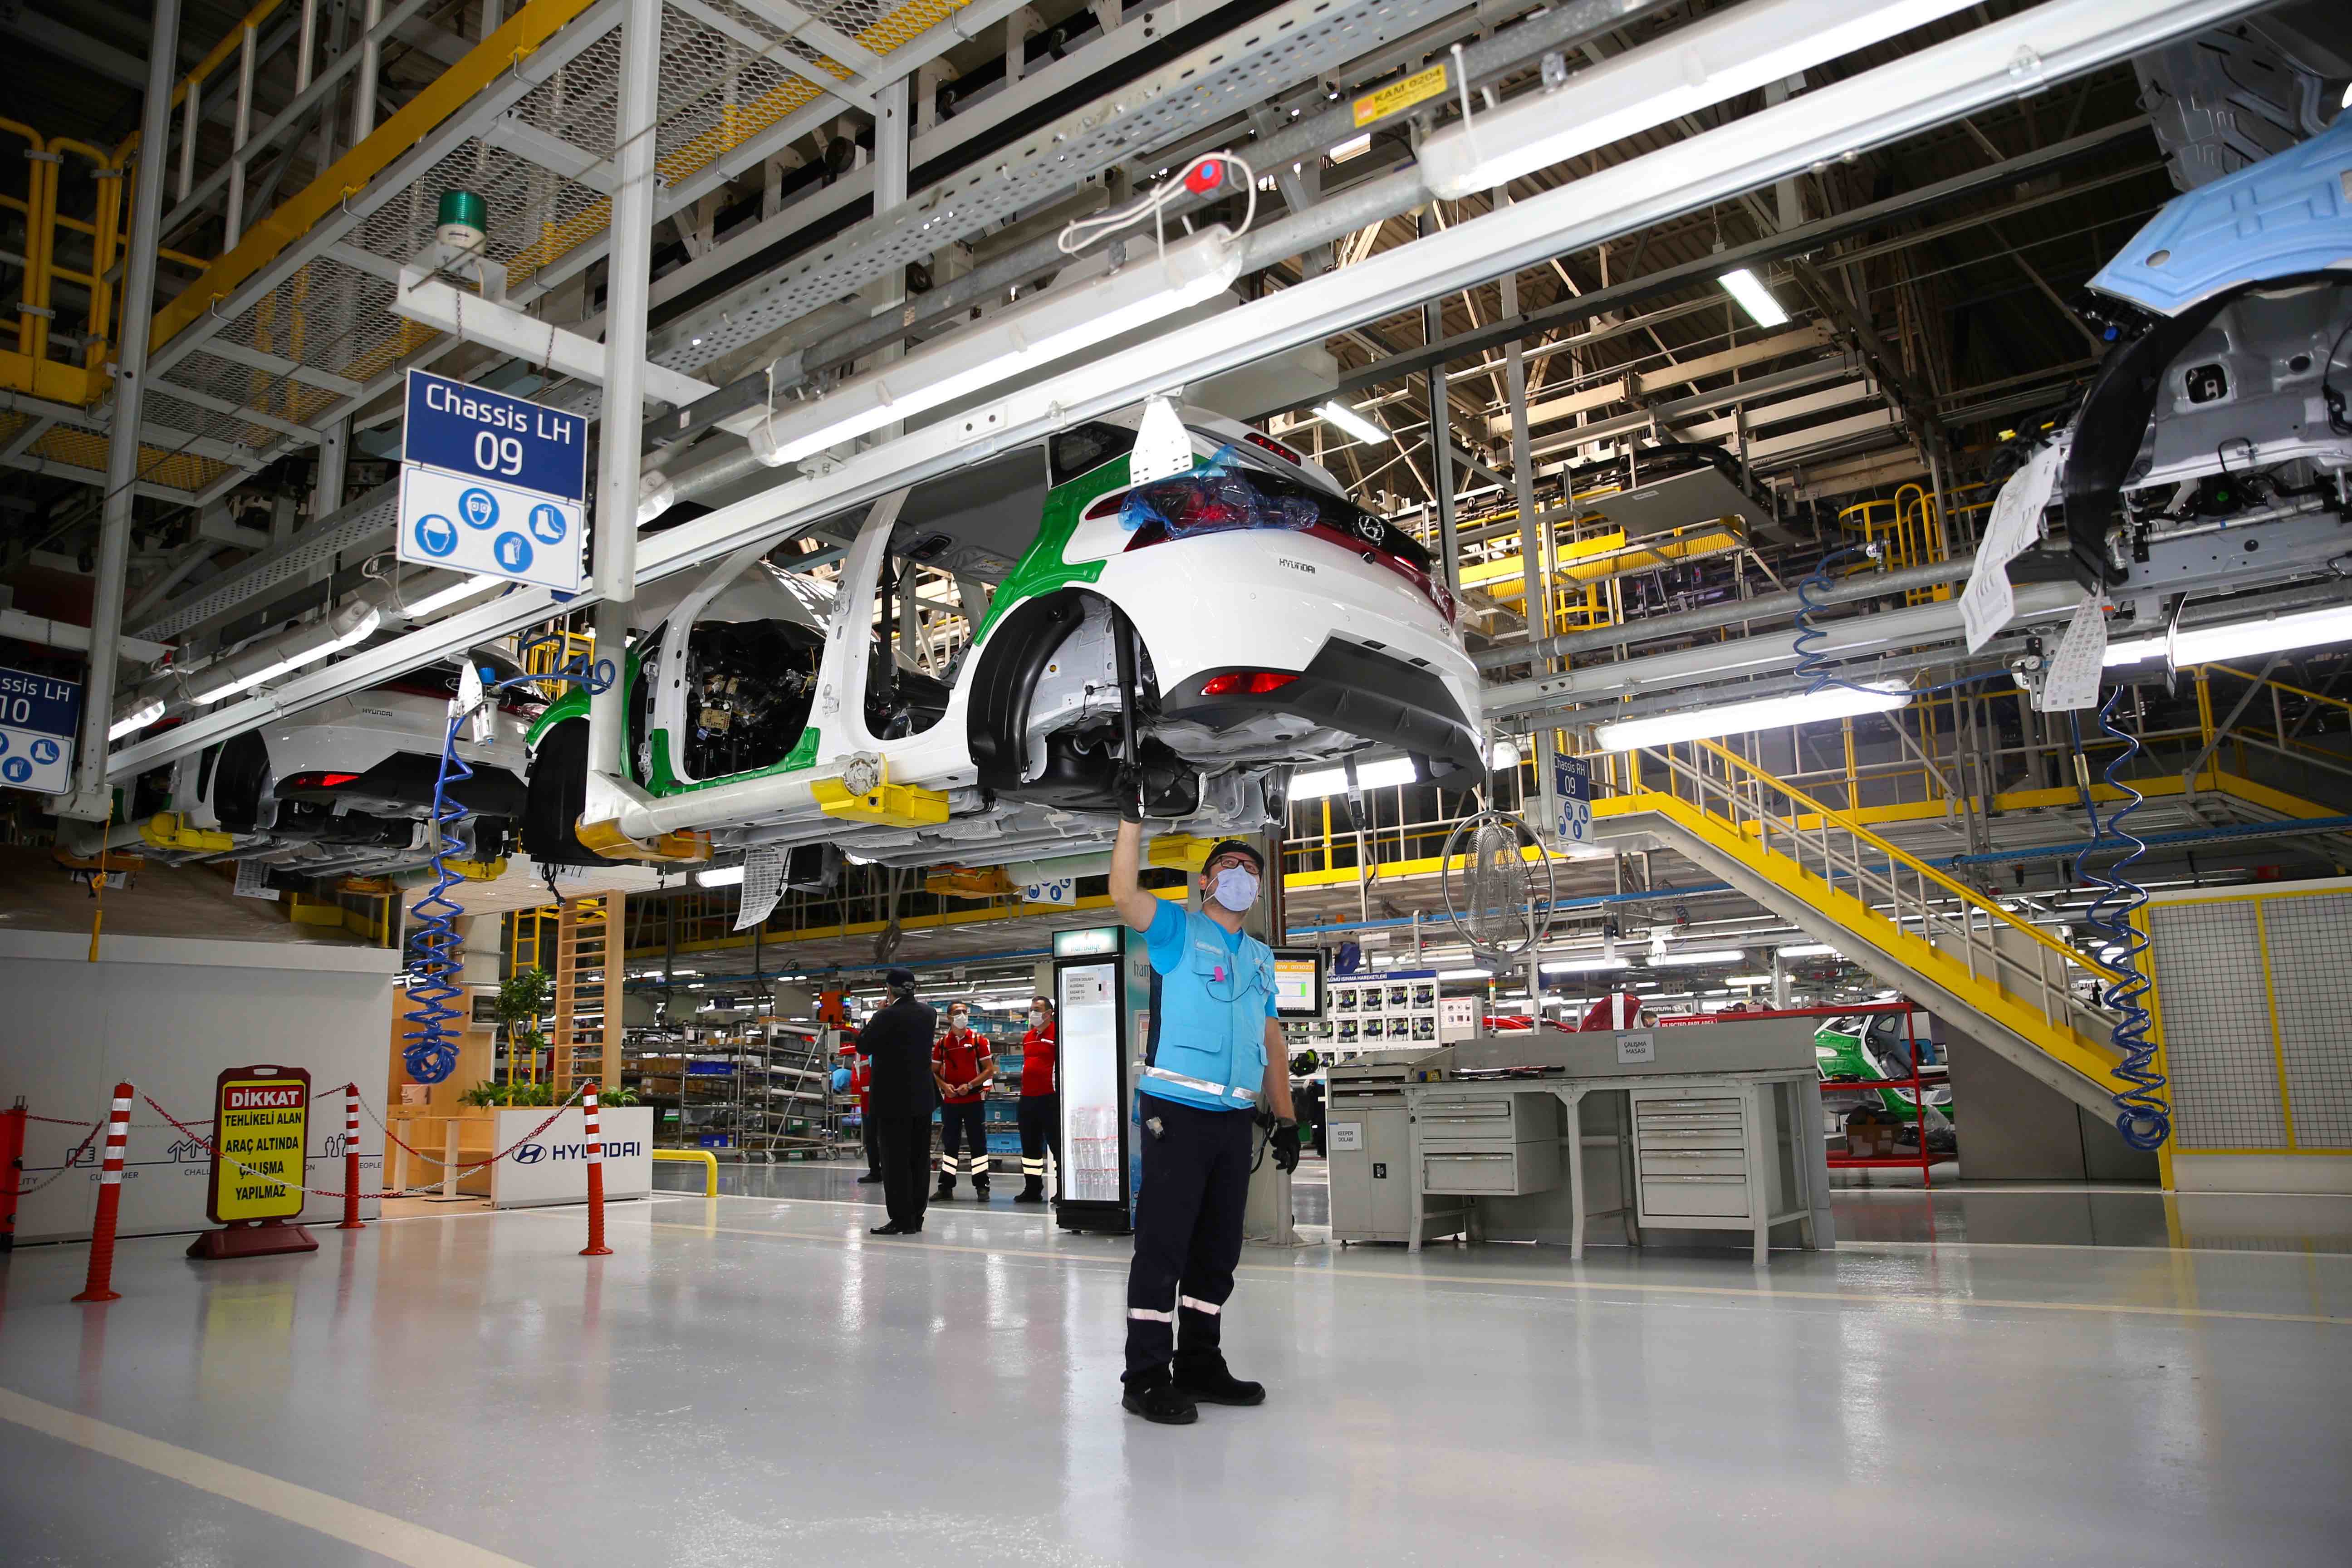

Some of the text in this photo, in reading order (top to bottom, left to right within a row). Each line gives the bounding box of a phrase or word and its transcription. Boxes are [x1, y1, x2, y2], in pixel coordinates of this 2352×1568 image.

[426, 383, 571, 445] Chassis LH
[474, 431, 523, 476] 09
[1279, 558, 1315, 574] HYUNDAI
[45, 682, 70, 702] LH
[0, 695, 30, 723] 10
[362, 708, 392, 716] HYUNDAI
[1554, 755, 1585, 776] Chassis RH
[1565, 775, 1576, 794] 09
[231, 1089, 299, 1107] DİKKAT
[225, 1111, 302, 1127] TEHLİKELİ ALAN
[225, 1137, 299, 1155] ARAÇ ALTINDA
[90, 1171, 138, 1181] CUMER
[236, 1185, 286, 1200] YAPILMAZ
